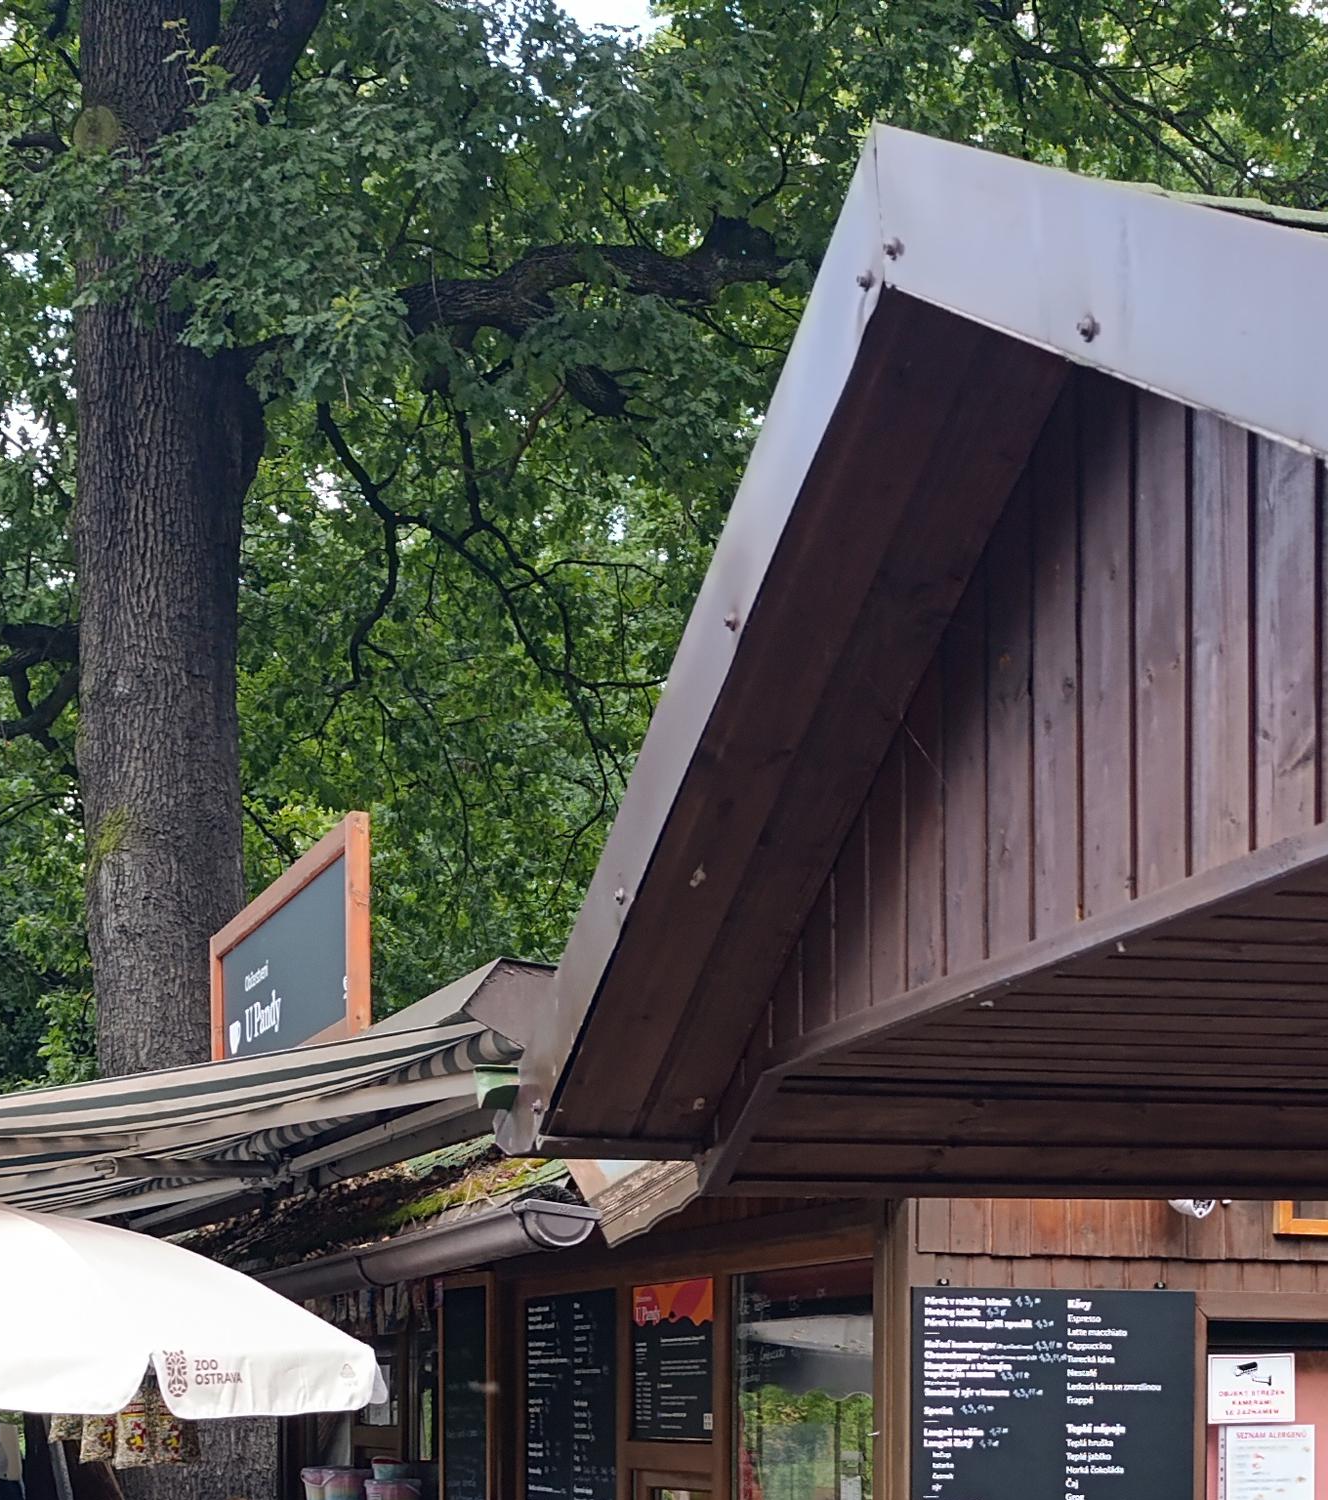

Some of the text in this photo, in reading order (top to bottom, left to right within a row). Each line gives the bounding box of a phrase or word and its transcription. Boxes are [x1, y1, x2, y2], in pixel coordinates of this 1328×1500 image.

[244, 989, 281, 1042] U Pandy
[1067, 1314, 1102, 1324] Espresso
[1067, 1328, 1128, 1337] Latte macchiato
[1067, 1342, 1112, 1351] Cappuccino
[195, 1359, 218, 1371] ZOO
[195, 1373, 243, 1385] OSTRAVA
[1067, 1382, 1094, 1391] Ledová
[1095, 1382, 1113, 1391] káva
[1065, 1477, 1079, 1489] Čaj
